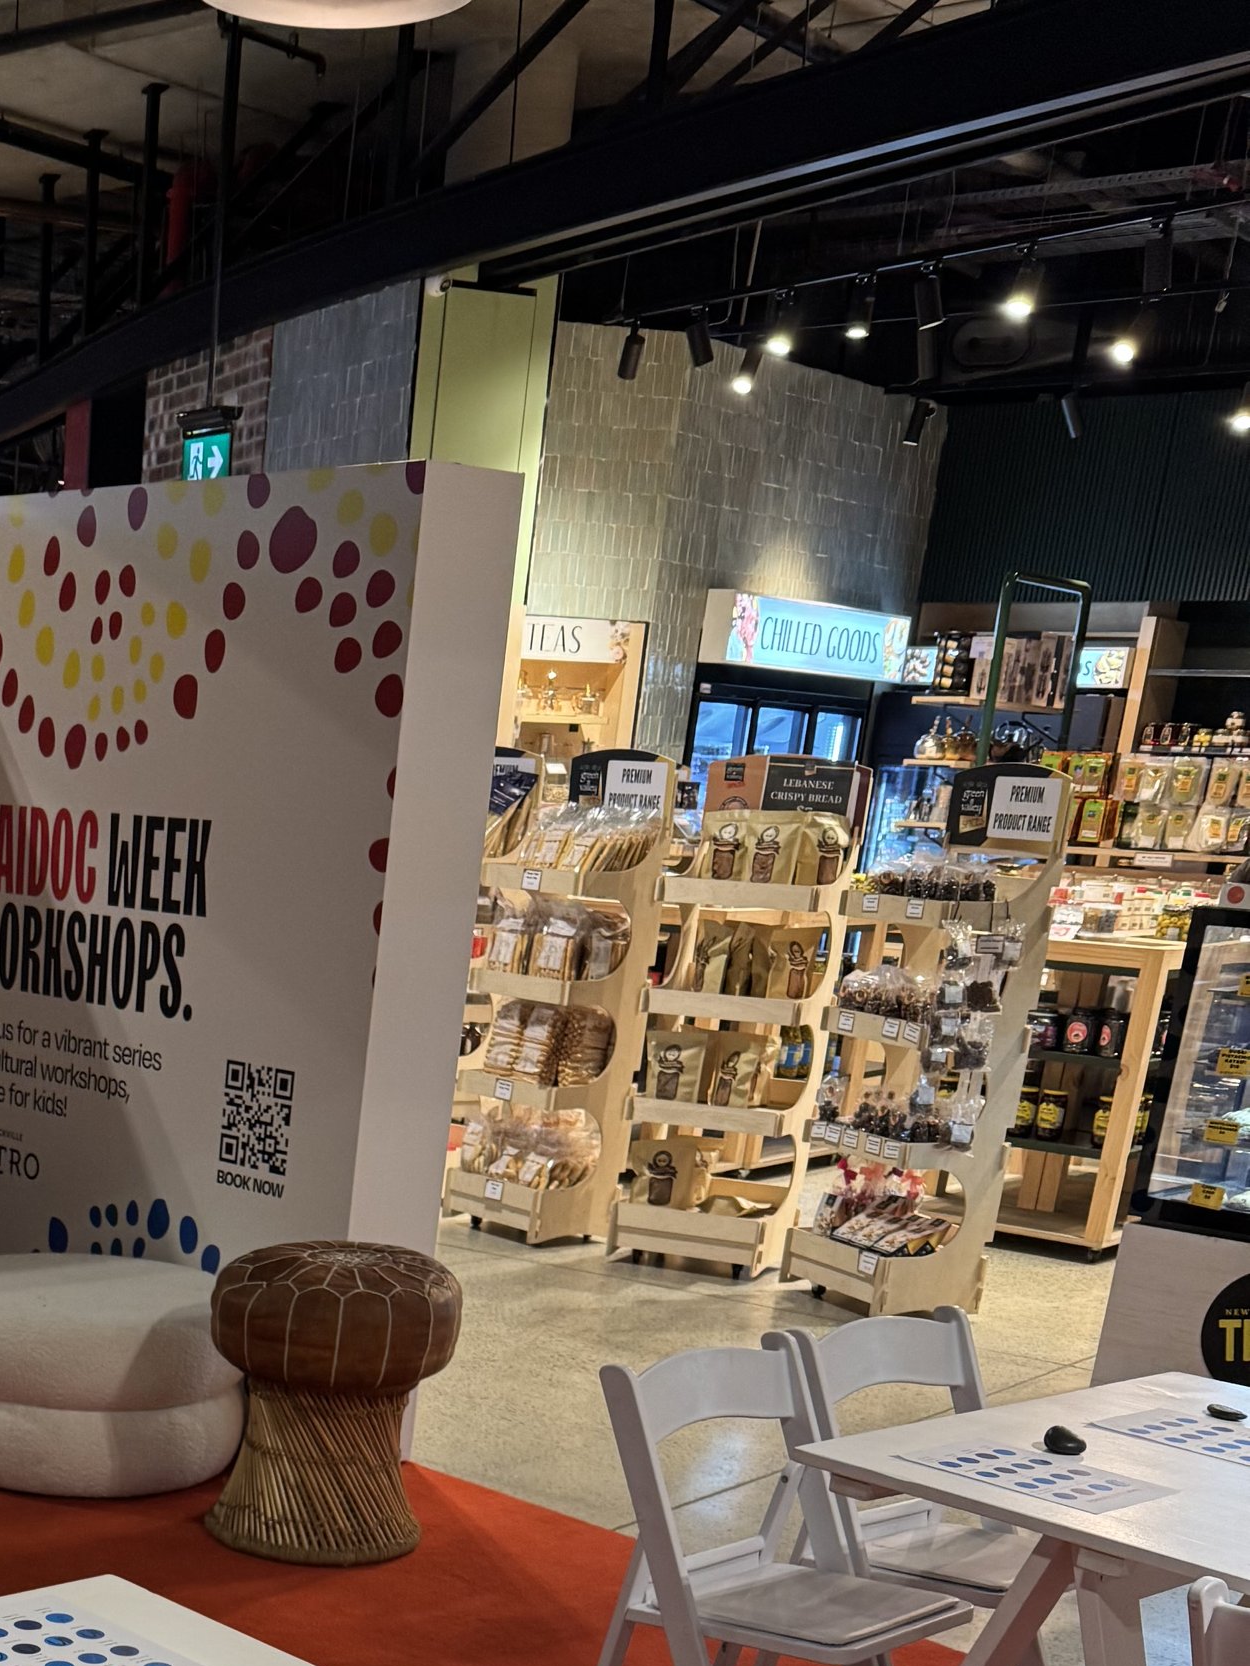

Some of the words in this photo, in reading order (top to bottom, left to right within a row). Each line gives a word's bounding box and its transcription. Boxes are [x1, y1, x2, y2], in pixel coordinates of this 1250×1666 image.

[527, 623, 582, 654] TEAS
[760, 616, 823, 656] CHILLED
[827, 626, 881, 664] GOODS
[621, 768, 653, 784] PREMIUM
[783, 778, 835, 791] LEBANESE
[608, 791, 638, 808] PRODUCT
[638, 793, 661, 810] RANGE
[770, 790, 807, 804] CRISPY
[808, 793, 842, 804] BREAD
[1009, 785, 1045, 803] PREMIUM
[993, 812, 1027, 832] PRODUCT
[1028, 814, 1053, 833] RANGE
[107, 812, 213, 917] WEEK
[17, 1020, 39, 1046] for
[41, 1030, 52, 1049] a
[54, 1026, 110, 1061] vibrant
[112, 1042, 163, 1072] series
[40, 1060, 131, 1103] workshops,
[8, 1082, 30, 1108] for
[32, 1086, 69, 1118] kids!
[216, 1168, 251, 1192] BOOK
[252, 1176, 285, 1200] NOW
[1225, 1308, 1250, 1316] NEW
